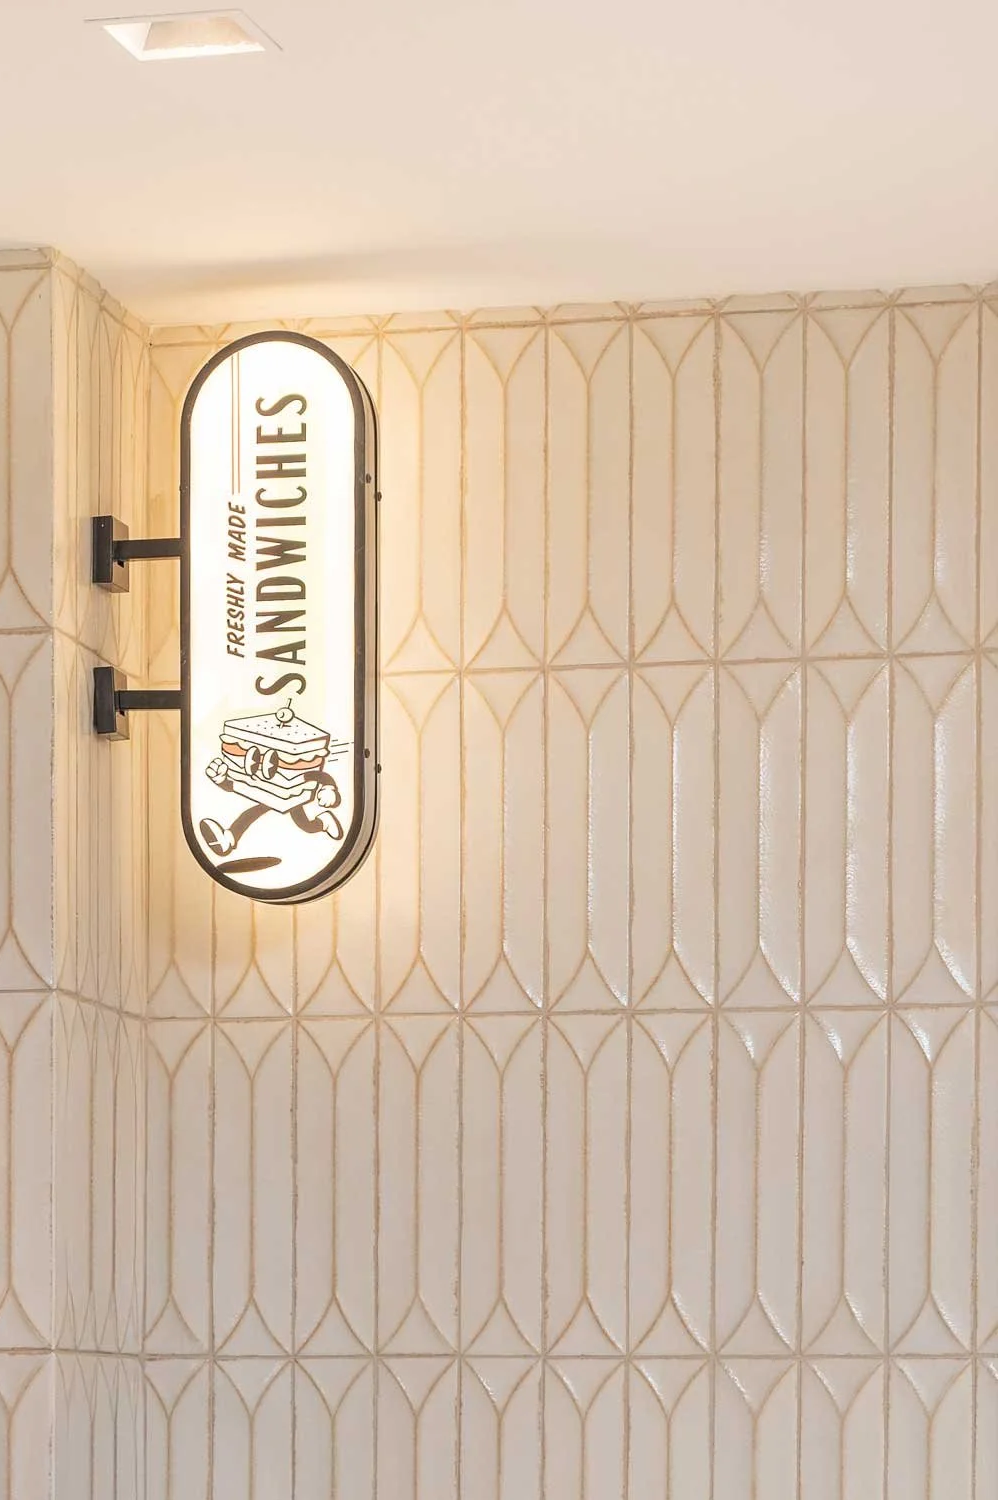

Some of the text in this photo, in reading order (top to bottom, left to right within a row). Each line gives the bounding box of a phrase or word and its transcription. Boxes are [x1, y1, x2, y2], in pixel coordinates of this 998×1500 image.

[226, 502, 247, 659] FRESHLY MADE
[254, 394, 307, 696] SANDWICHES
